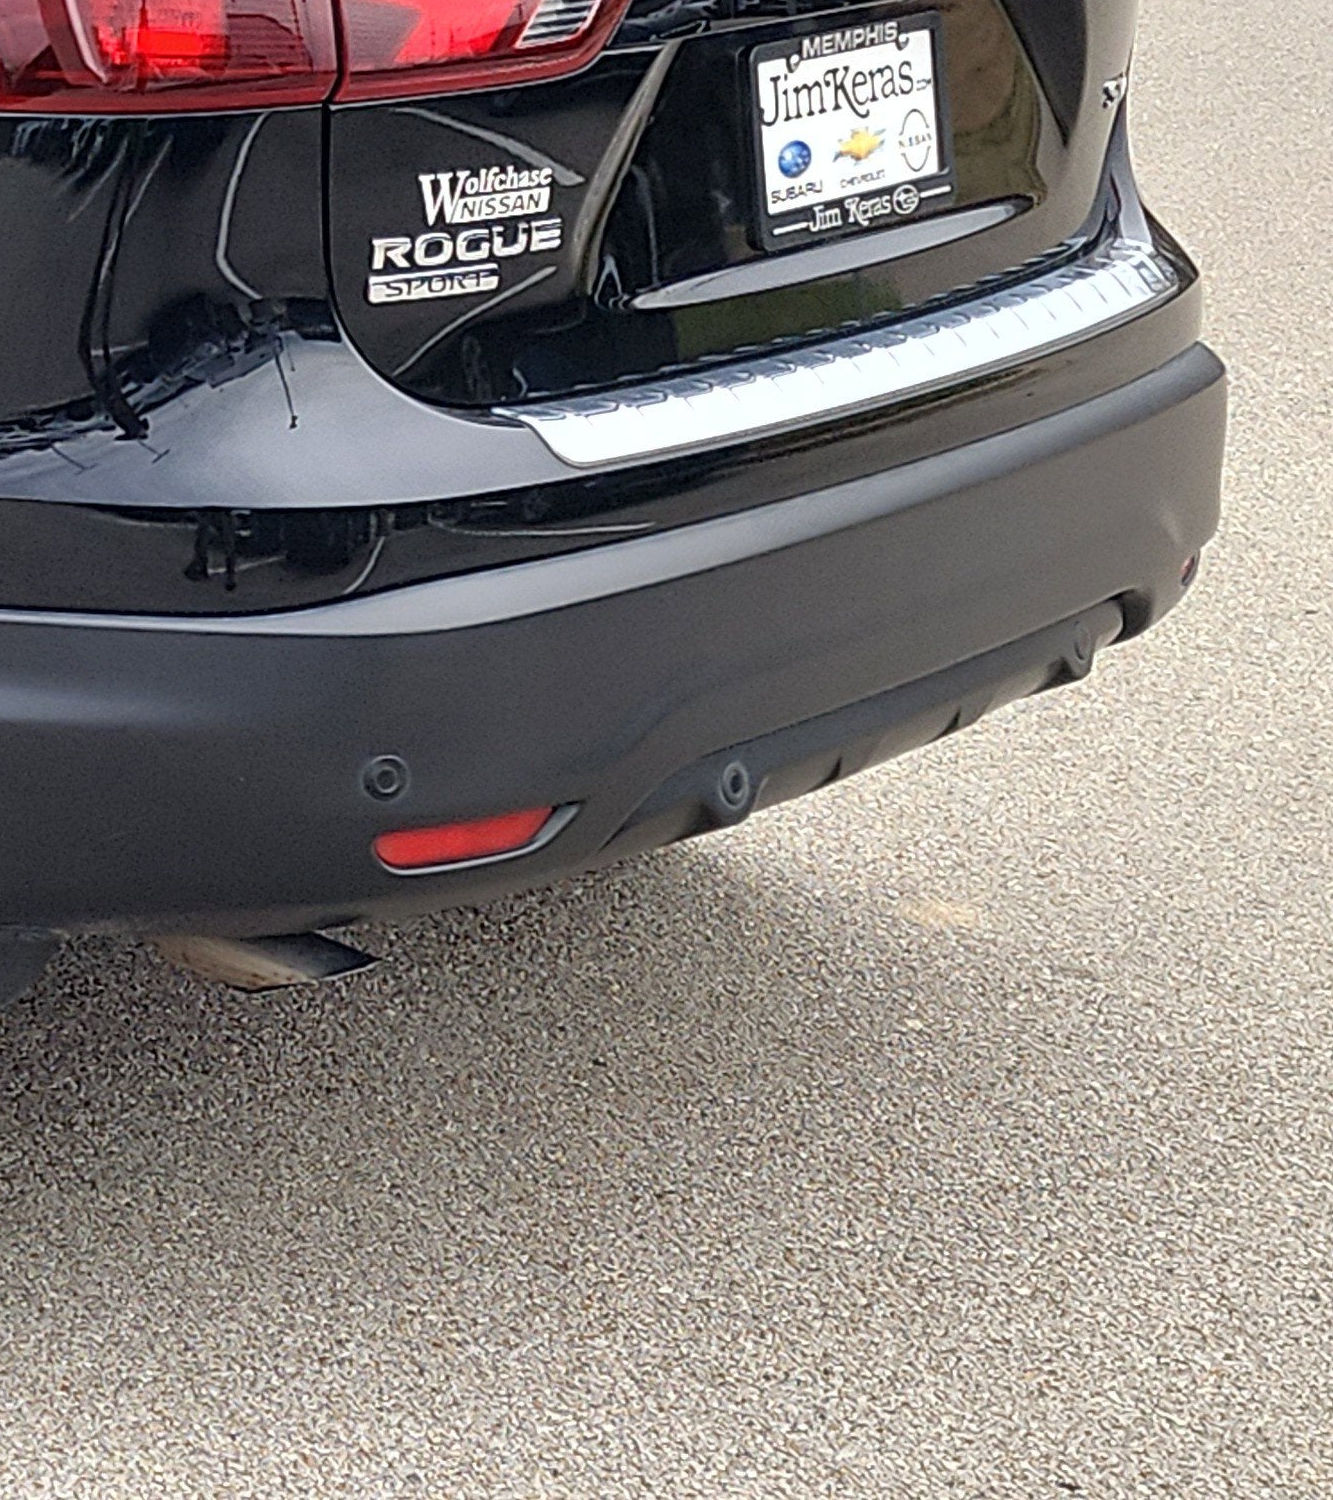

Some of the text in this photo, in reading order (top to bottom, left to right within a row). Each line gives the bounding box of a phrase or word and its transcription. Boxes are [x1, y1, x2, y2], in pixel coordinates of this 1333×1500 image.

[801, 22, 898, 59] MEMPHIS
[418, 166, 553, 226] Wolfchase
[460, 193, 541, 218] NISSAN
[771, 180, 823, 204] SUBARU
[809, 195, 892, 232] Jim Keras
[372, 217, 562, 269] ROGUE
[385, 272, 492, 297] SPORT
